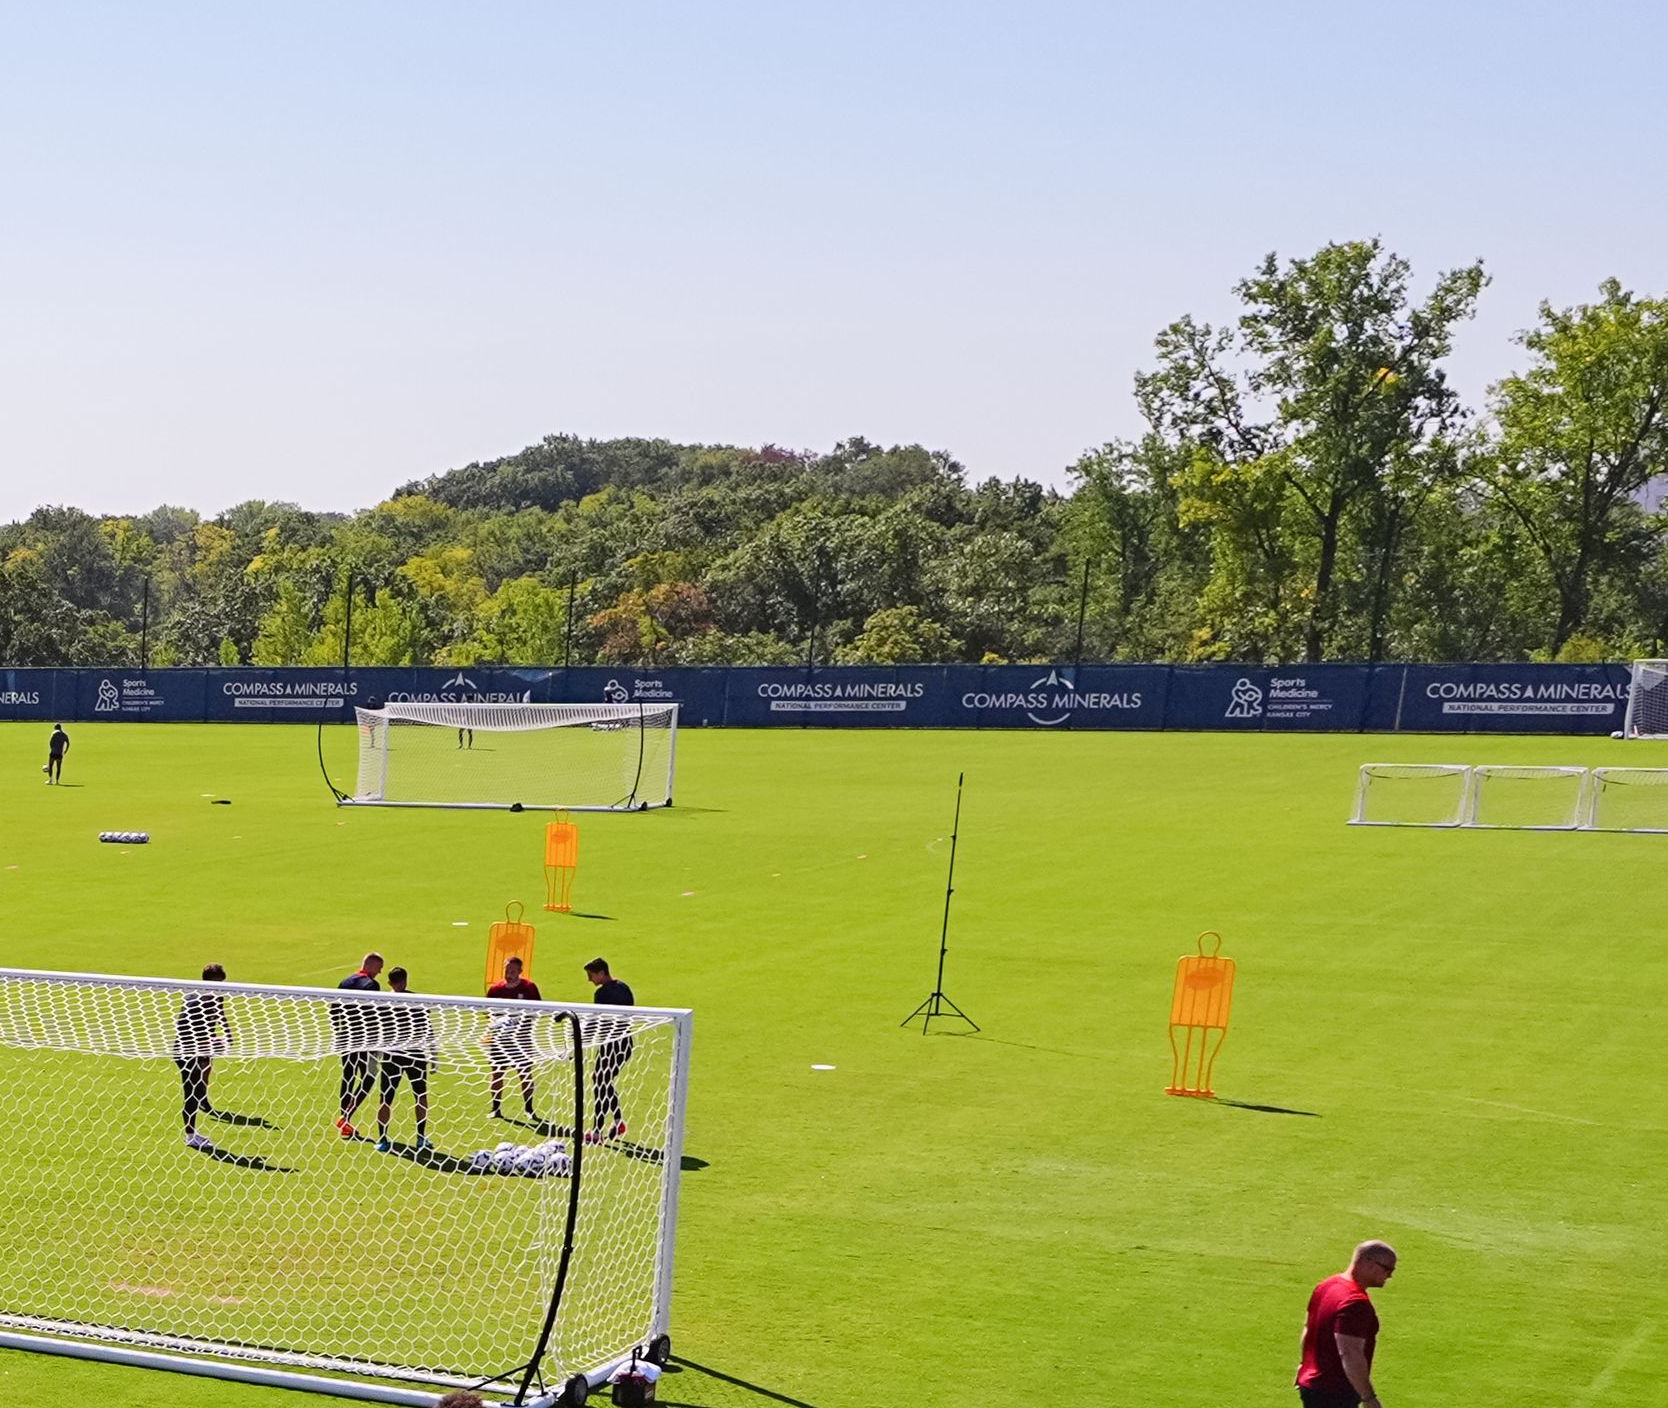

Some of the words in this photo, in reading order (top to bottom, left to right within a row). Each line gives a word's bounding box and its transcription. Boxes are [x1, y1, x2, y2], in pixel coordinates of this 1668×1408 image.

[223, 682, 284, 695] COMPASS
[293, 682, 358, 695] MINERALS
[634, 679, 663, 689] Sports
[1270, 678, 1306, 689] Sports
[632, 689, 674, 698] Medicine
[757, 683, 833, 698] COMPASS
[844, 683, 924, 697] MINERALS
[1269, 688, 1319, 698] Medicine
[1426, 683, 1522, 699] COMPASS
[962, 693, 1048, 708] COMPASS
[1051, 693, 1142, 708] MINERALS
[1448, 704, 1495, 712] NATIONAL
[1497, 704, 1567, 713] PERFORMANCE
[1570, 704, 1608, 713] CENTER
